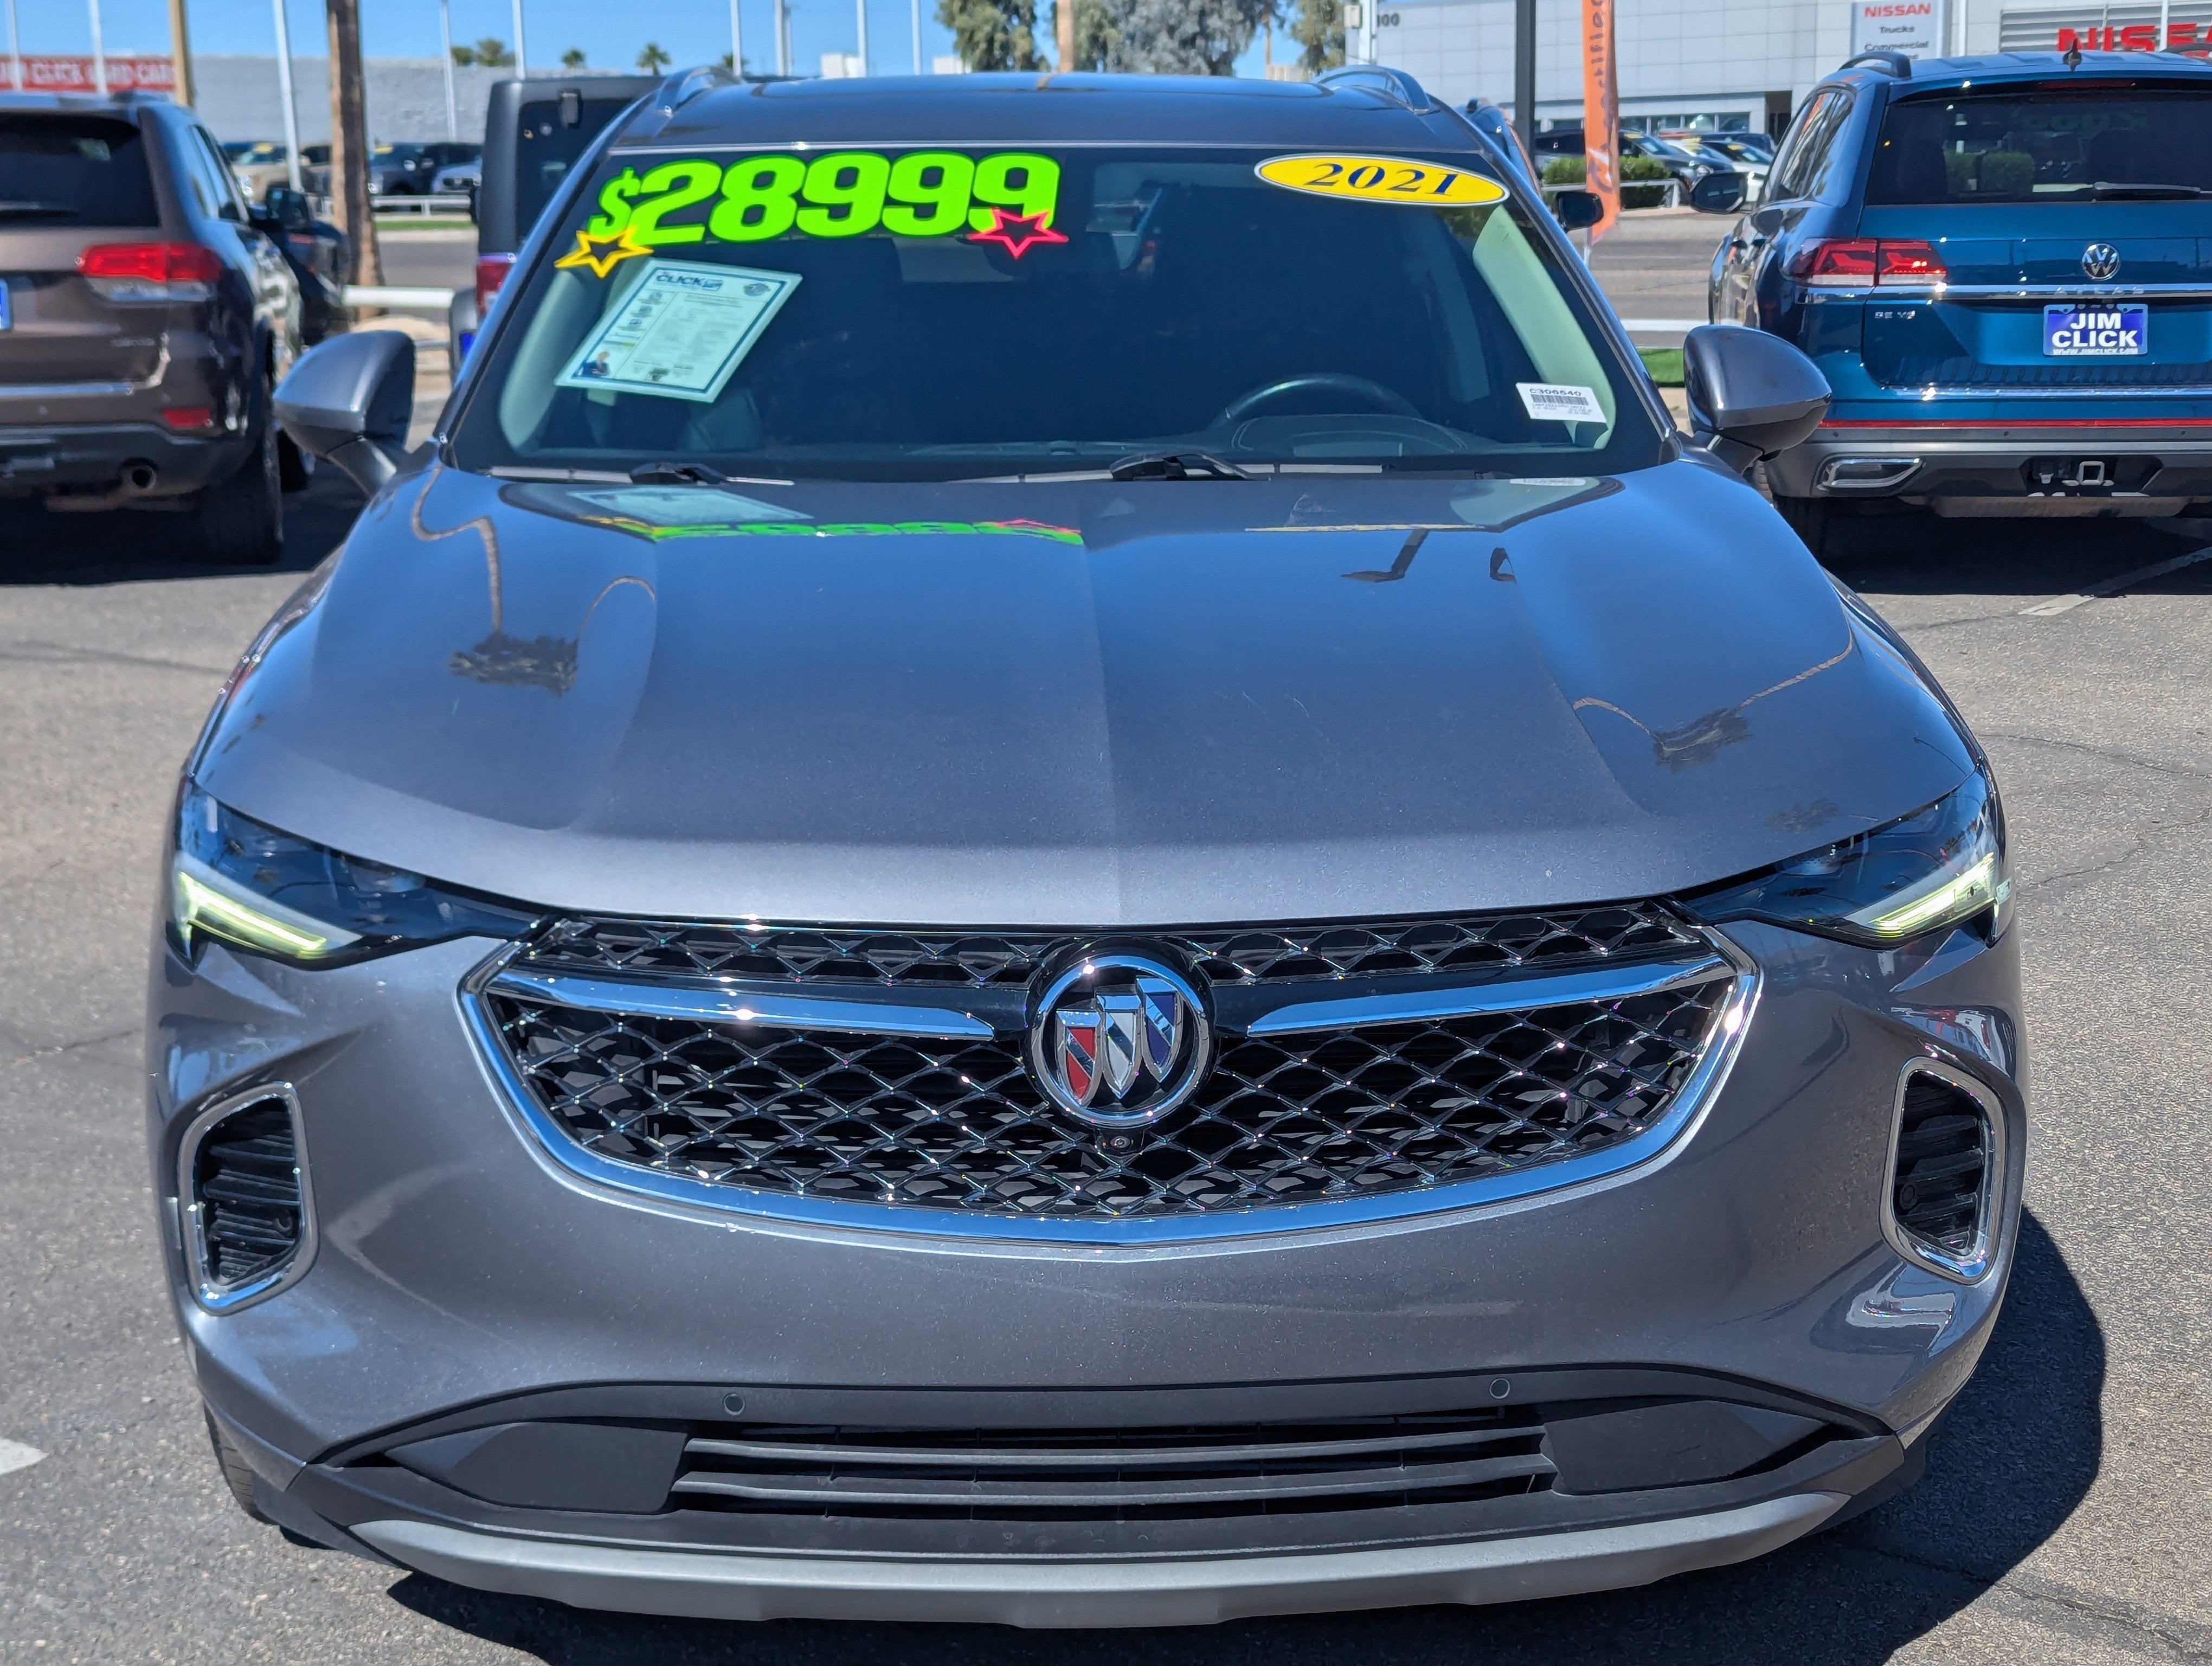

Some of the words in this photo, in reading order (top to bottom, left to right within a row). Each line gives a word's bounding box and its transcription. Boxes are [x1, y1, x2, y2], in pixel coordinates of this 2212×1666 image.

[1864, 3, 1931, 17] NISSAN
[1880, 25, 1915, 34] Trucks
[1304, 162, 1459, 197] 2021
[589, 151, 1061, 246] $28999
[2054, 286, 2145, 296] ATLAS
[2070, 312, 2121, 330] JIM
[2052, 330, 2138, 348] CLICK
